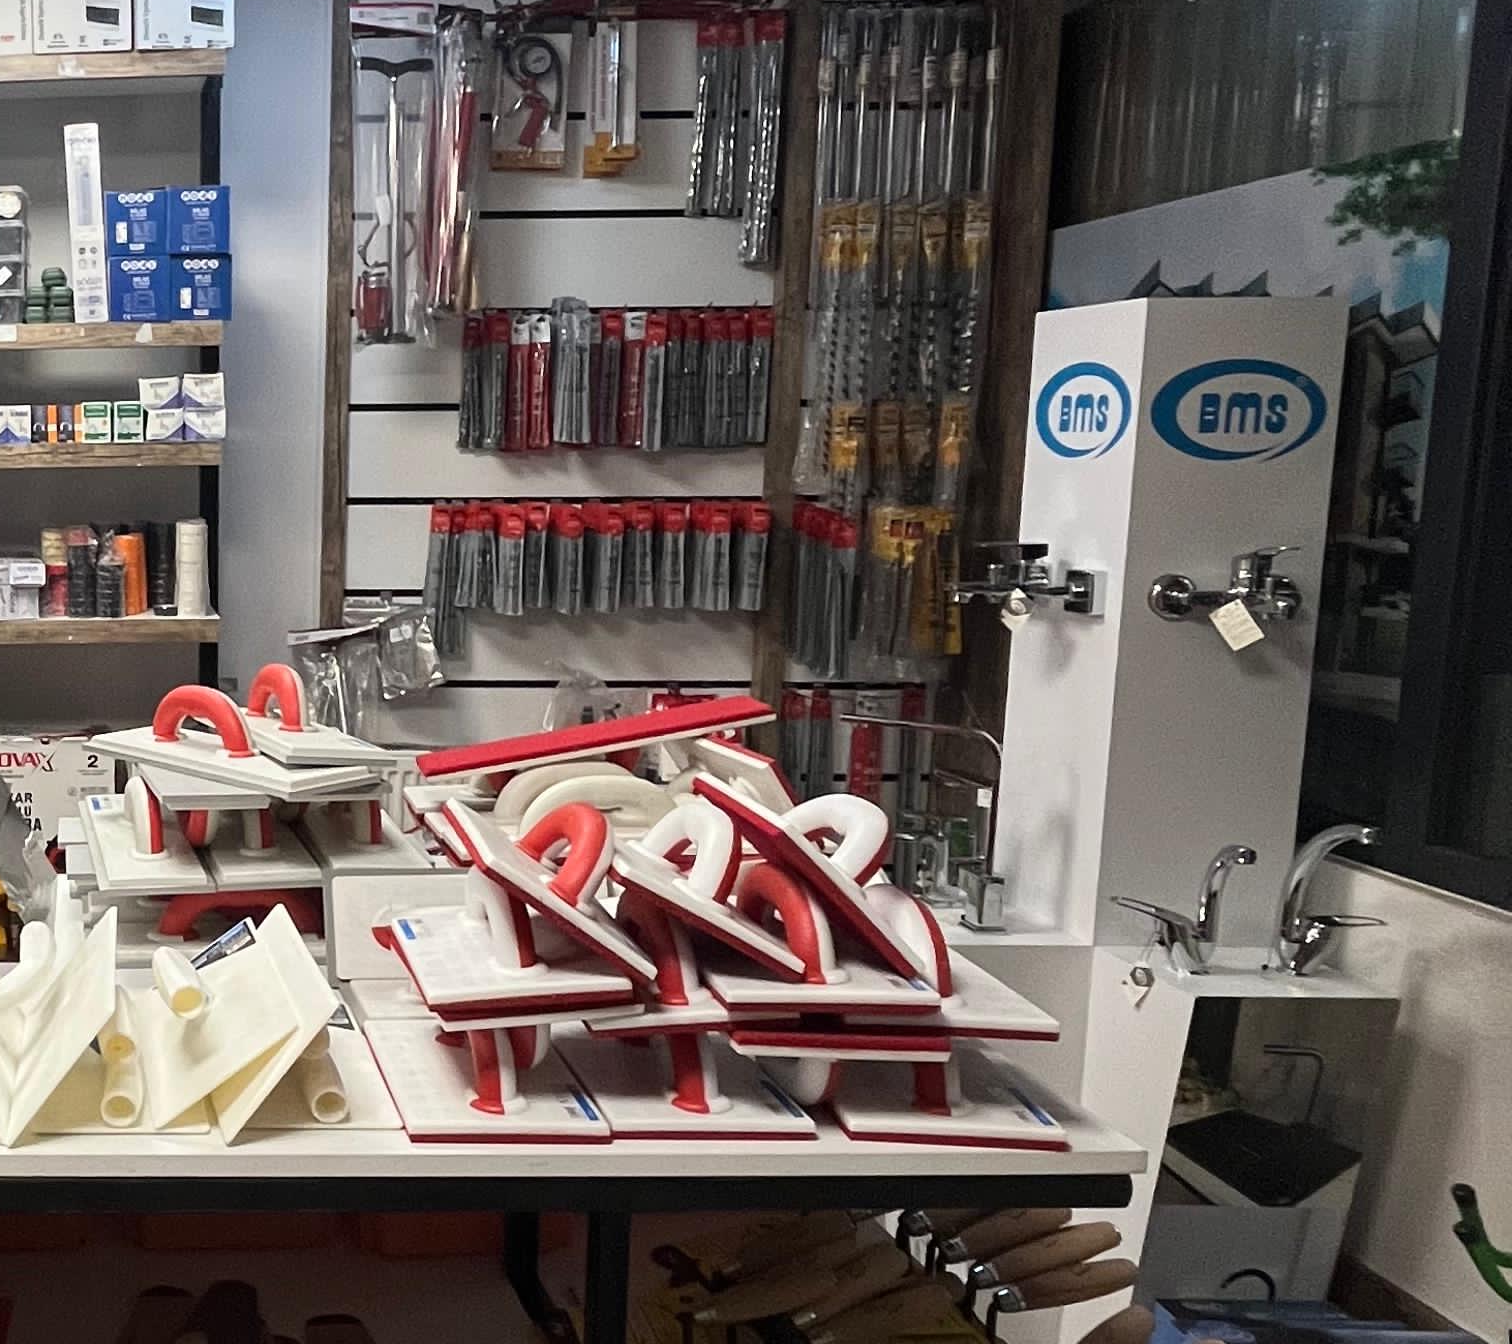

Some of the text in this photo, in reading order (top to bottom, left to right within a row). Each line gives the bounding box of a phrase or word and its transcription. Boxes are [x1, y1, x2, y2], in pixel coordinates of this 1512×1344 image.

[1059, 394, 1109, 434] BMS
[1198, 392, 1288, 435] BMS
[87, 755, 99, 768] 2
